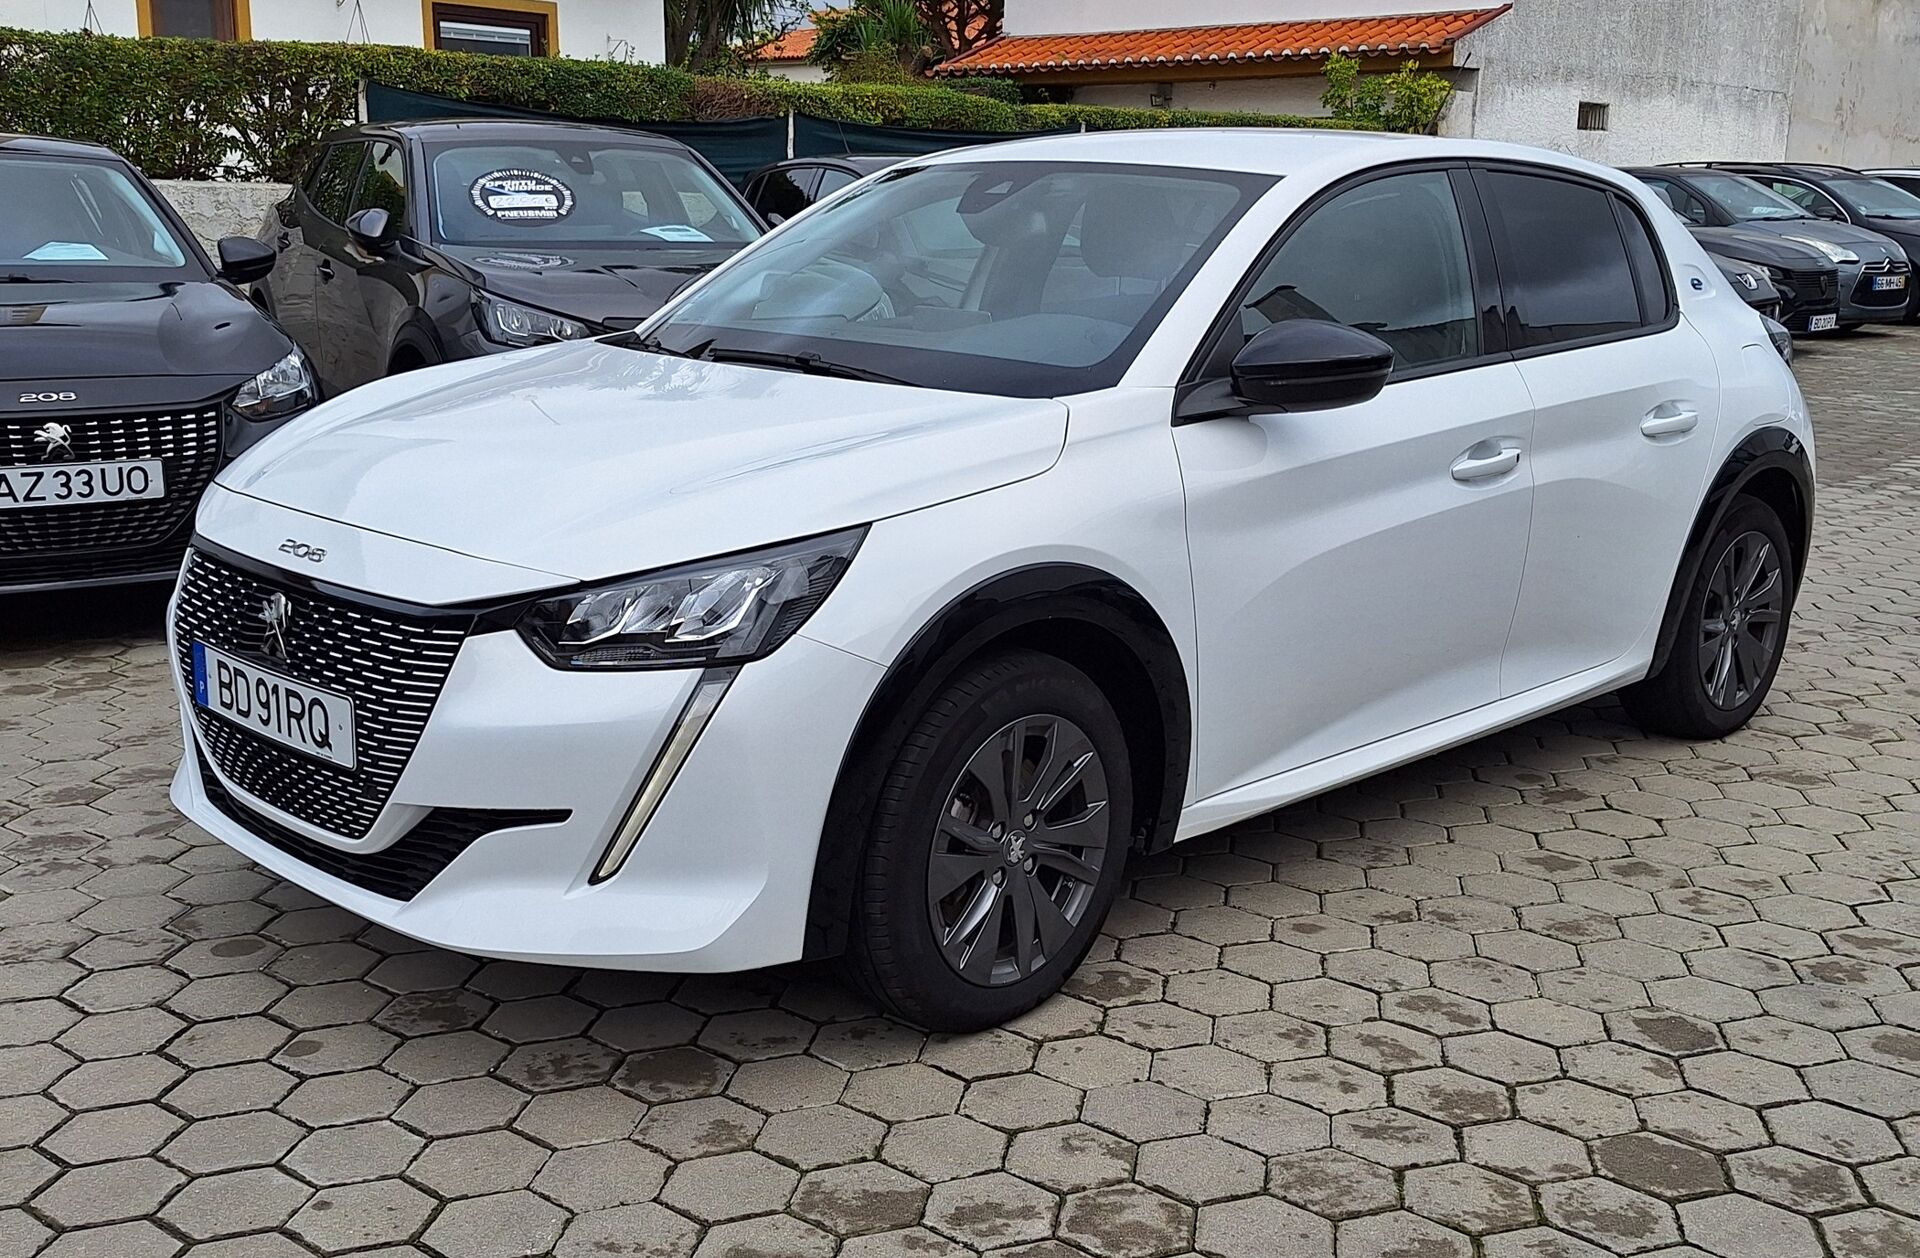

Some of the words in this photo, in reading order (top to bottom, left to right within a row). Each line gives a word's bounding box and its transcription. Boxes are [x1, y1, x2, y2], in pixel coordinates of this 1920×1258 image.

[19, 392, 77, 402] 208
[0, 471, 46, 503] AZ
[52, 469, 94, 500] 33
[100, 466, 149, 496] UO
[278, 539, 327, 563] 208
[217, 658, 251, 719] BD
[255, 677, 283, 734] 91
[285, 687, 333, 752] RQ
